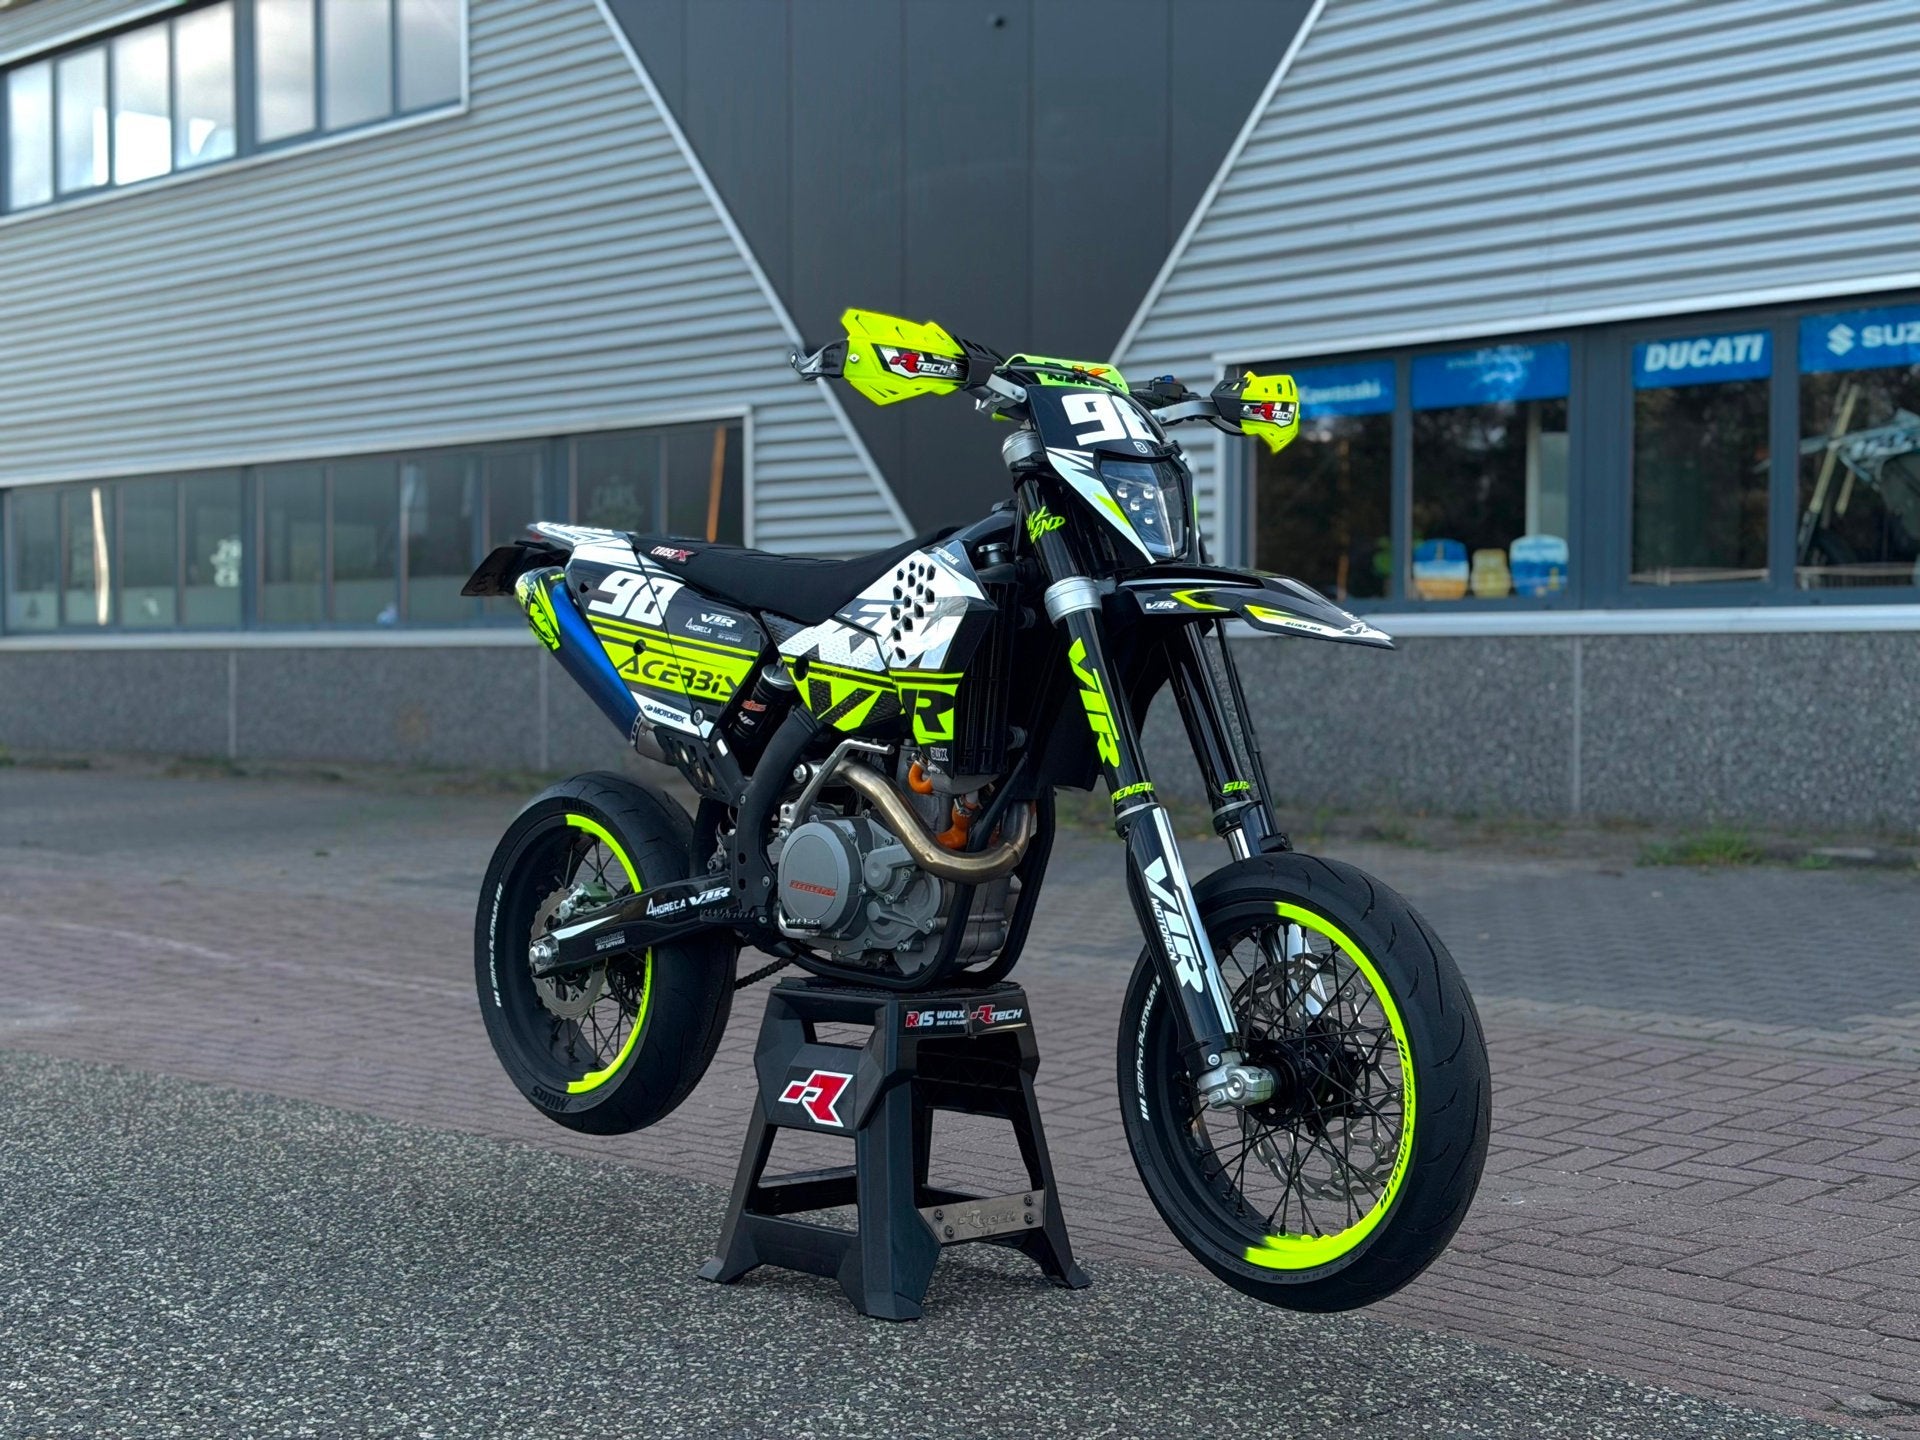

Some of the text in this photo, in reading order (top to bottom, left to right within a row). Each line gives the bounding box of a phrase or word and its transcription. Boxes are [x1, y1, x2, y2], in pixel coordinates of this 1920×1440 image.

[1644, 333, 1765, 373] DUCATI
[588, 570, 686, 626] 98
[653, 706, 686, 724] MOTOREX
[1151, 897, 1179, 962] MOTOREN
[936, 1010, 966, 1019] WORX
[1138, 983, 1158, 1047] PLATINUM
[531, 1085, 572, 1112] Mitas
